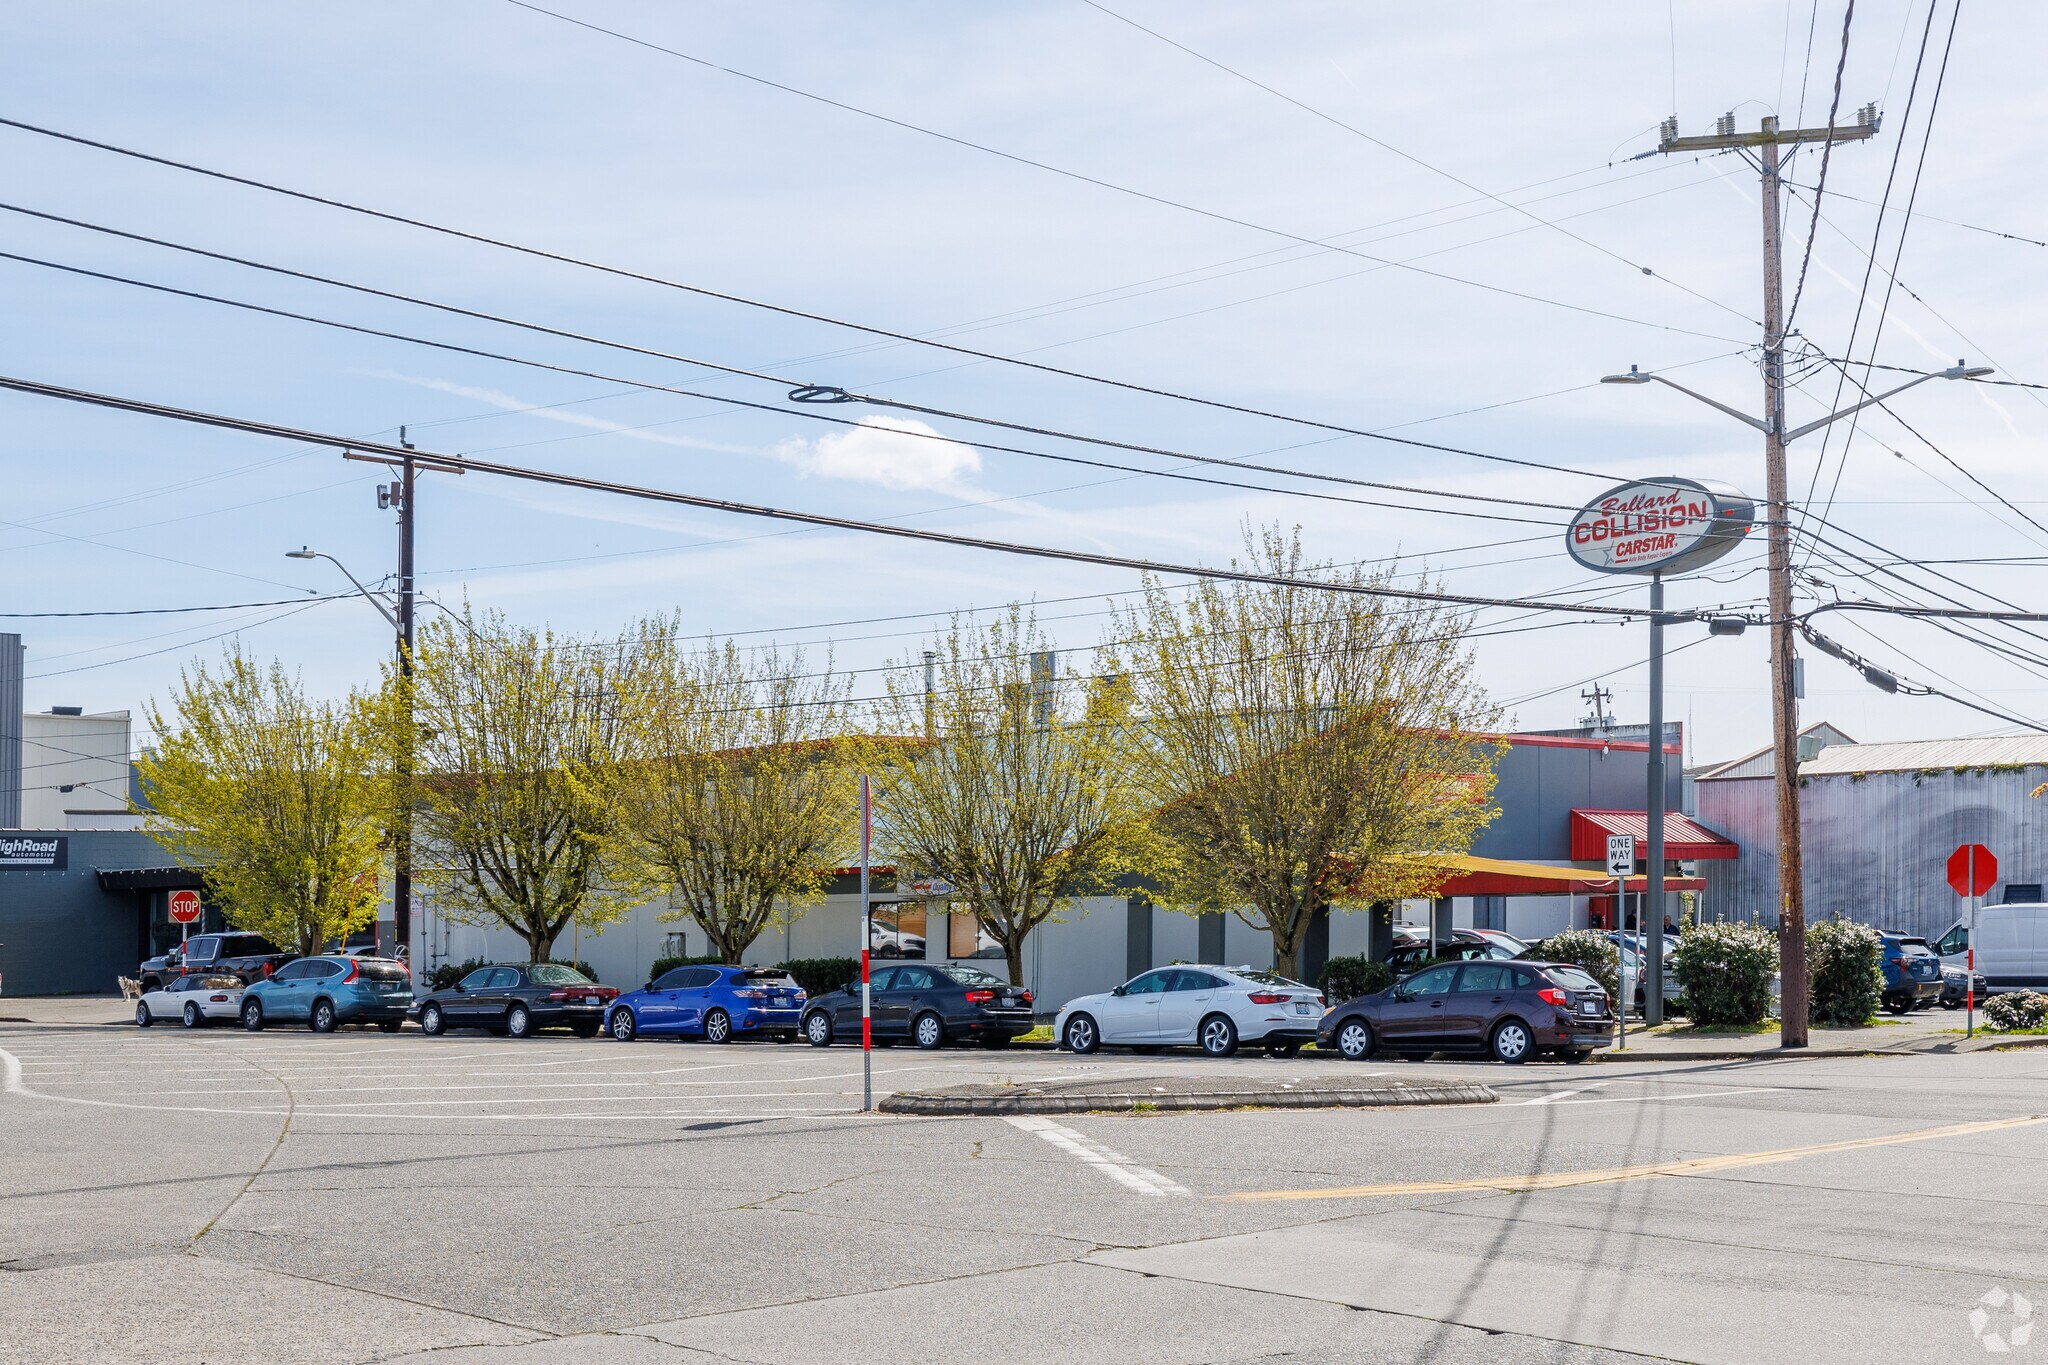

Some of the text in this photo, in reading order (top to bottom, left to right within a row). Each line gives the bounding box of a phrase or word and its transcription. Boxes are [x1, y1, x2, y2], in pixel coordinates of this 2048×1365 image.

[1600, 488, 1680, 517] Ballard
[1575, 501, 1707, 544] COLLISION
[1615, 533, 1676, 557] CARSTAR
[0, 839, 58, 855] ighRoad
[1610, 838, 1630, 848] ONE
[1610, 850, 1631, 860] WAY
[932, 882, 952, 892] Quality
[173, 901, 199, 912] STOP
